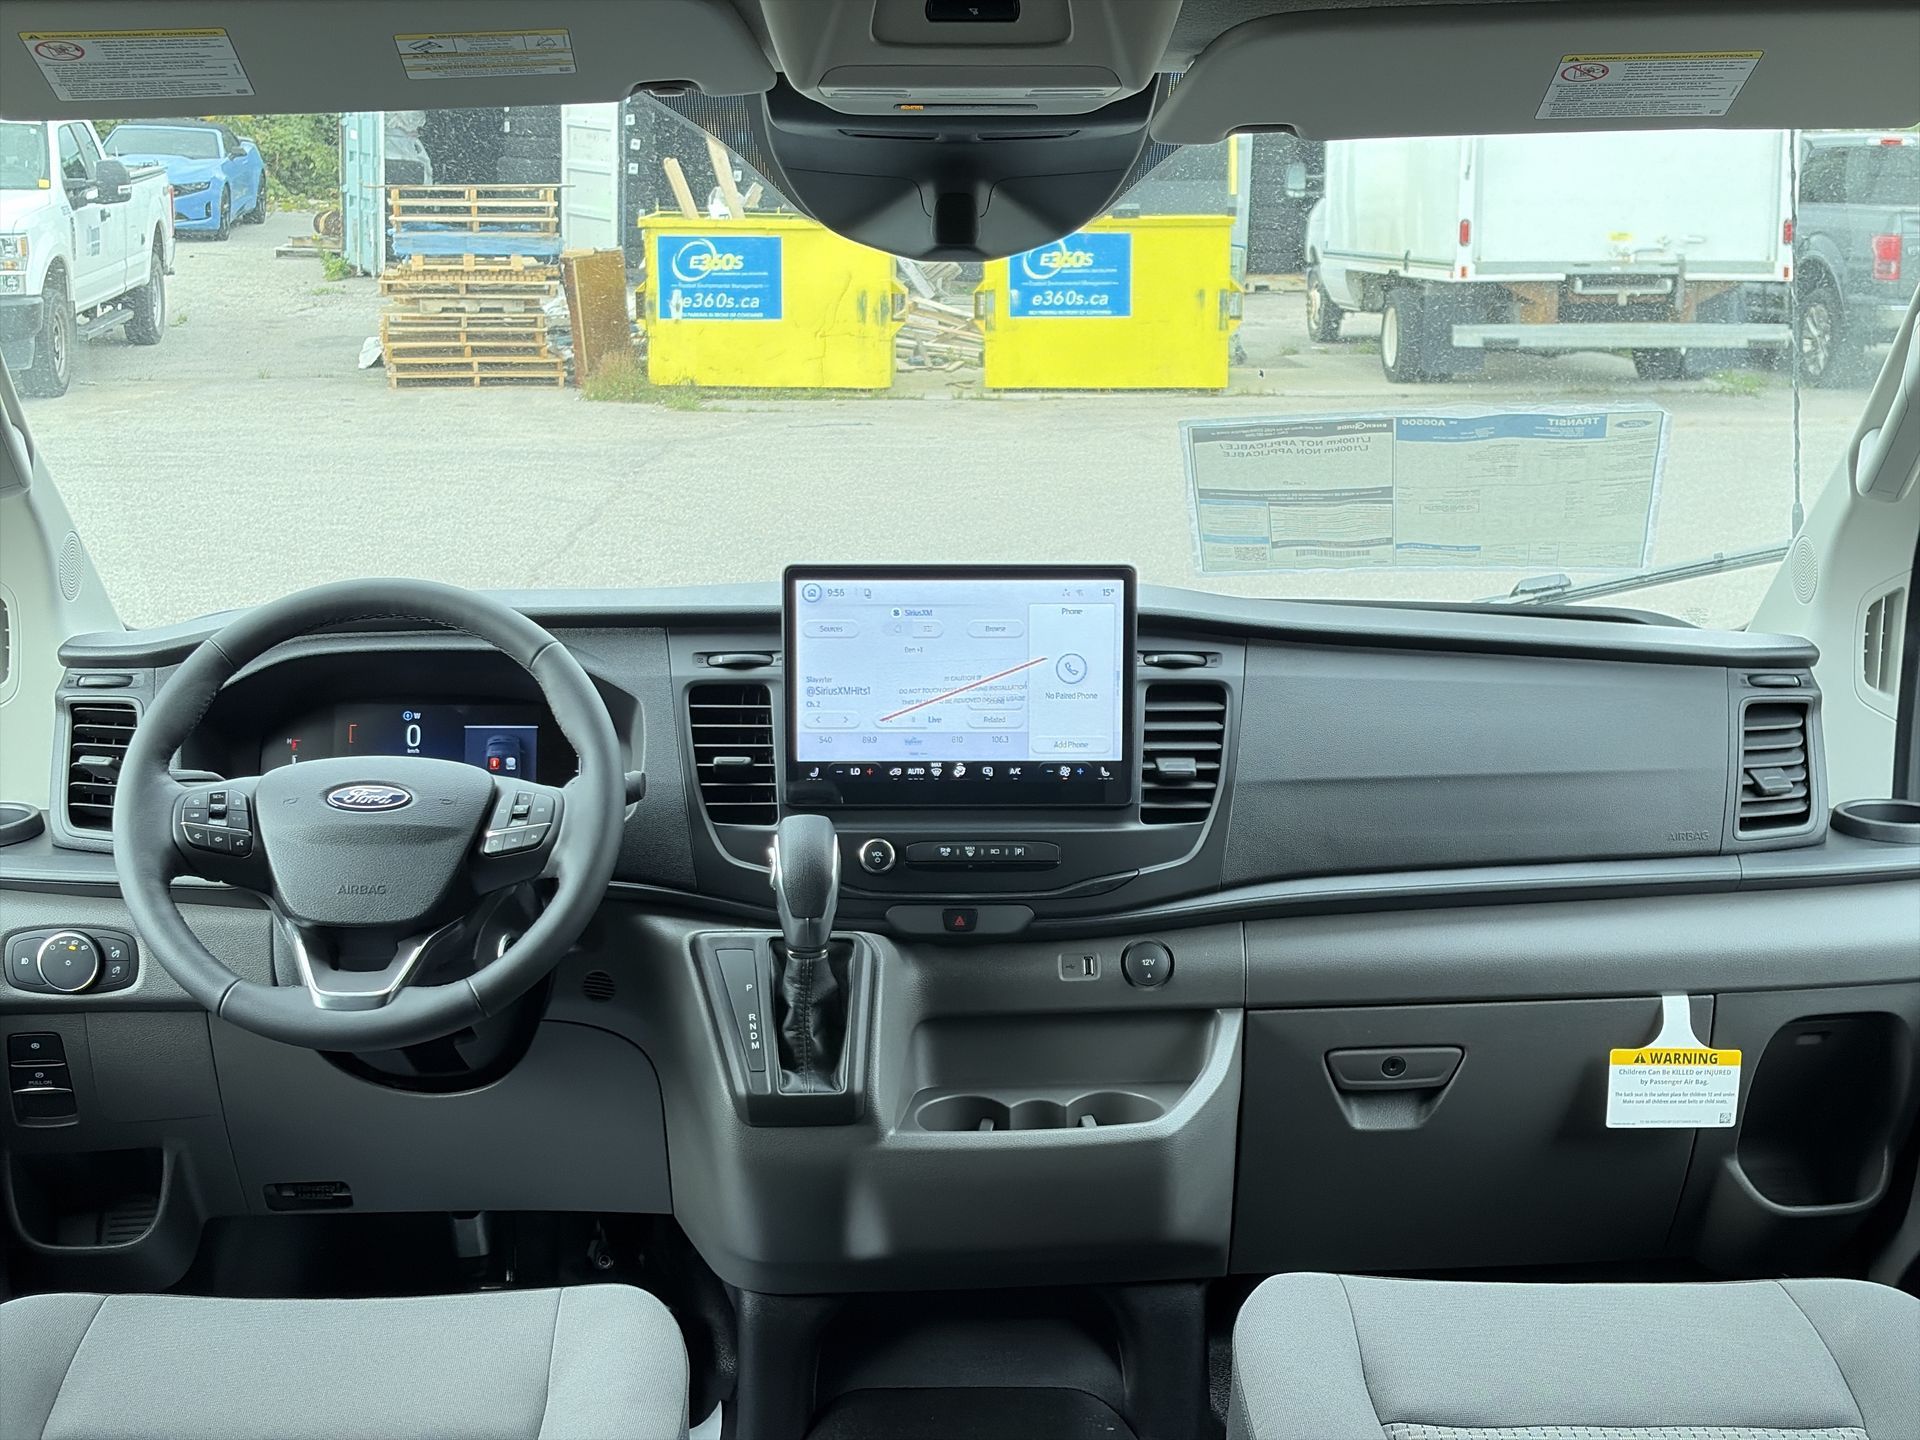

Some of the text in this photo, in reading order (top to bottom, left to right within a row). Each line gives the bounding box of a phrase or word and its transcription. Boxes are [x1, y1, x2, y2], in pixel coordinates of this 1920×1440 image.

[682, 292, 760, 308] e360s.ca
[1032, 290, 1108, 306] e360s.ca
[904, 609, 933, 617] SiriusXM
[1062, 608, 1083, 616] Phone
[806, 686, 871, 698] @SiriusXMHits1
[1045, 692, 1098, 700] No Paired Phone
[406, 724, 421, 747] 0
[1054, 741, 1089, 749] Add Phone
[850, 767, 861, 776] LO
[907, 768, 925, 776] AUTO
[1010, 767, 1022, 775] A/C
[1667, 830, 1710, 842] AIRBAG
[336, 884, 386, 895] AIRBAG
[746, 984, 753, 992] P
[752, 1042, 760, 1050] M
[1650, 1052, 1718, 1064] WARNING
[1704, 1068, 1732, 1076] INJURED
